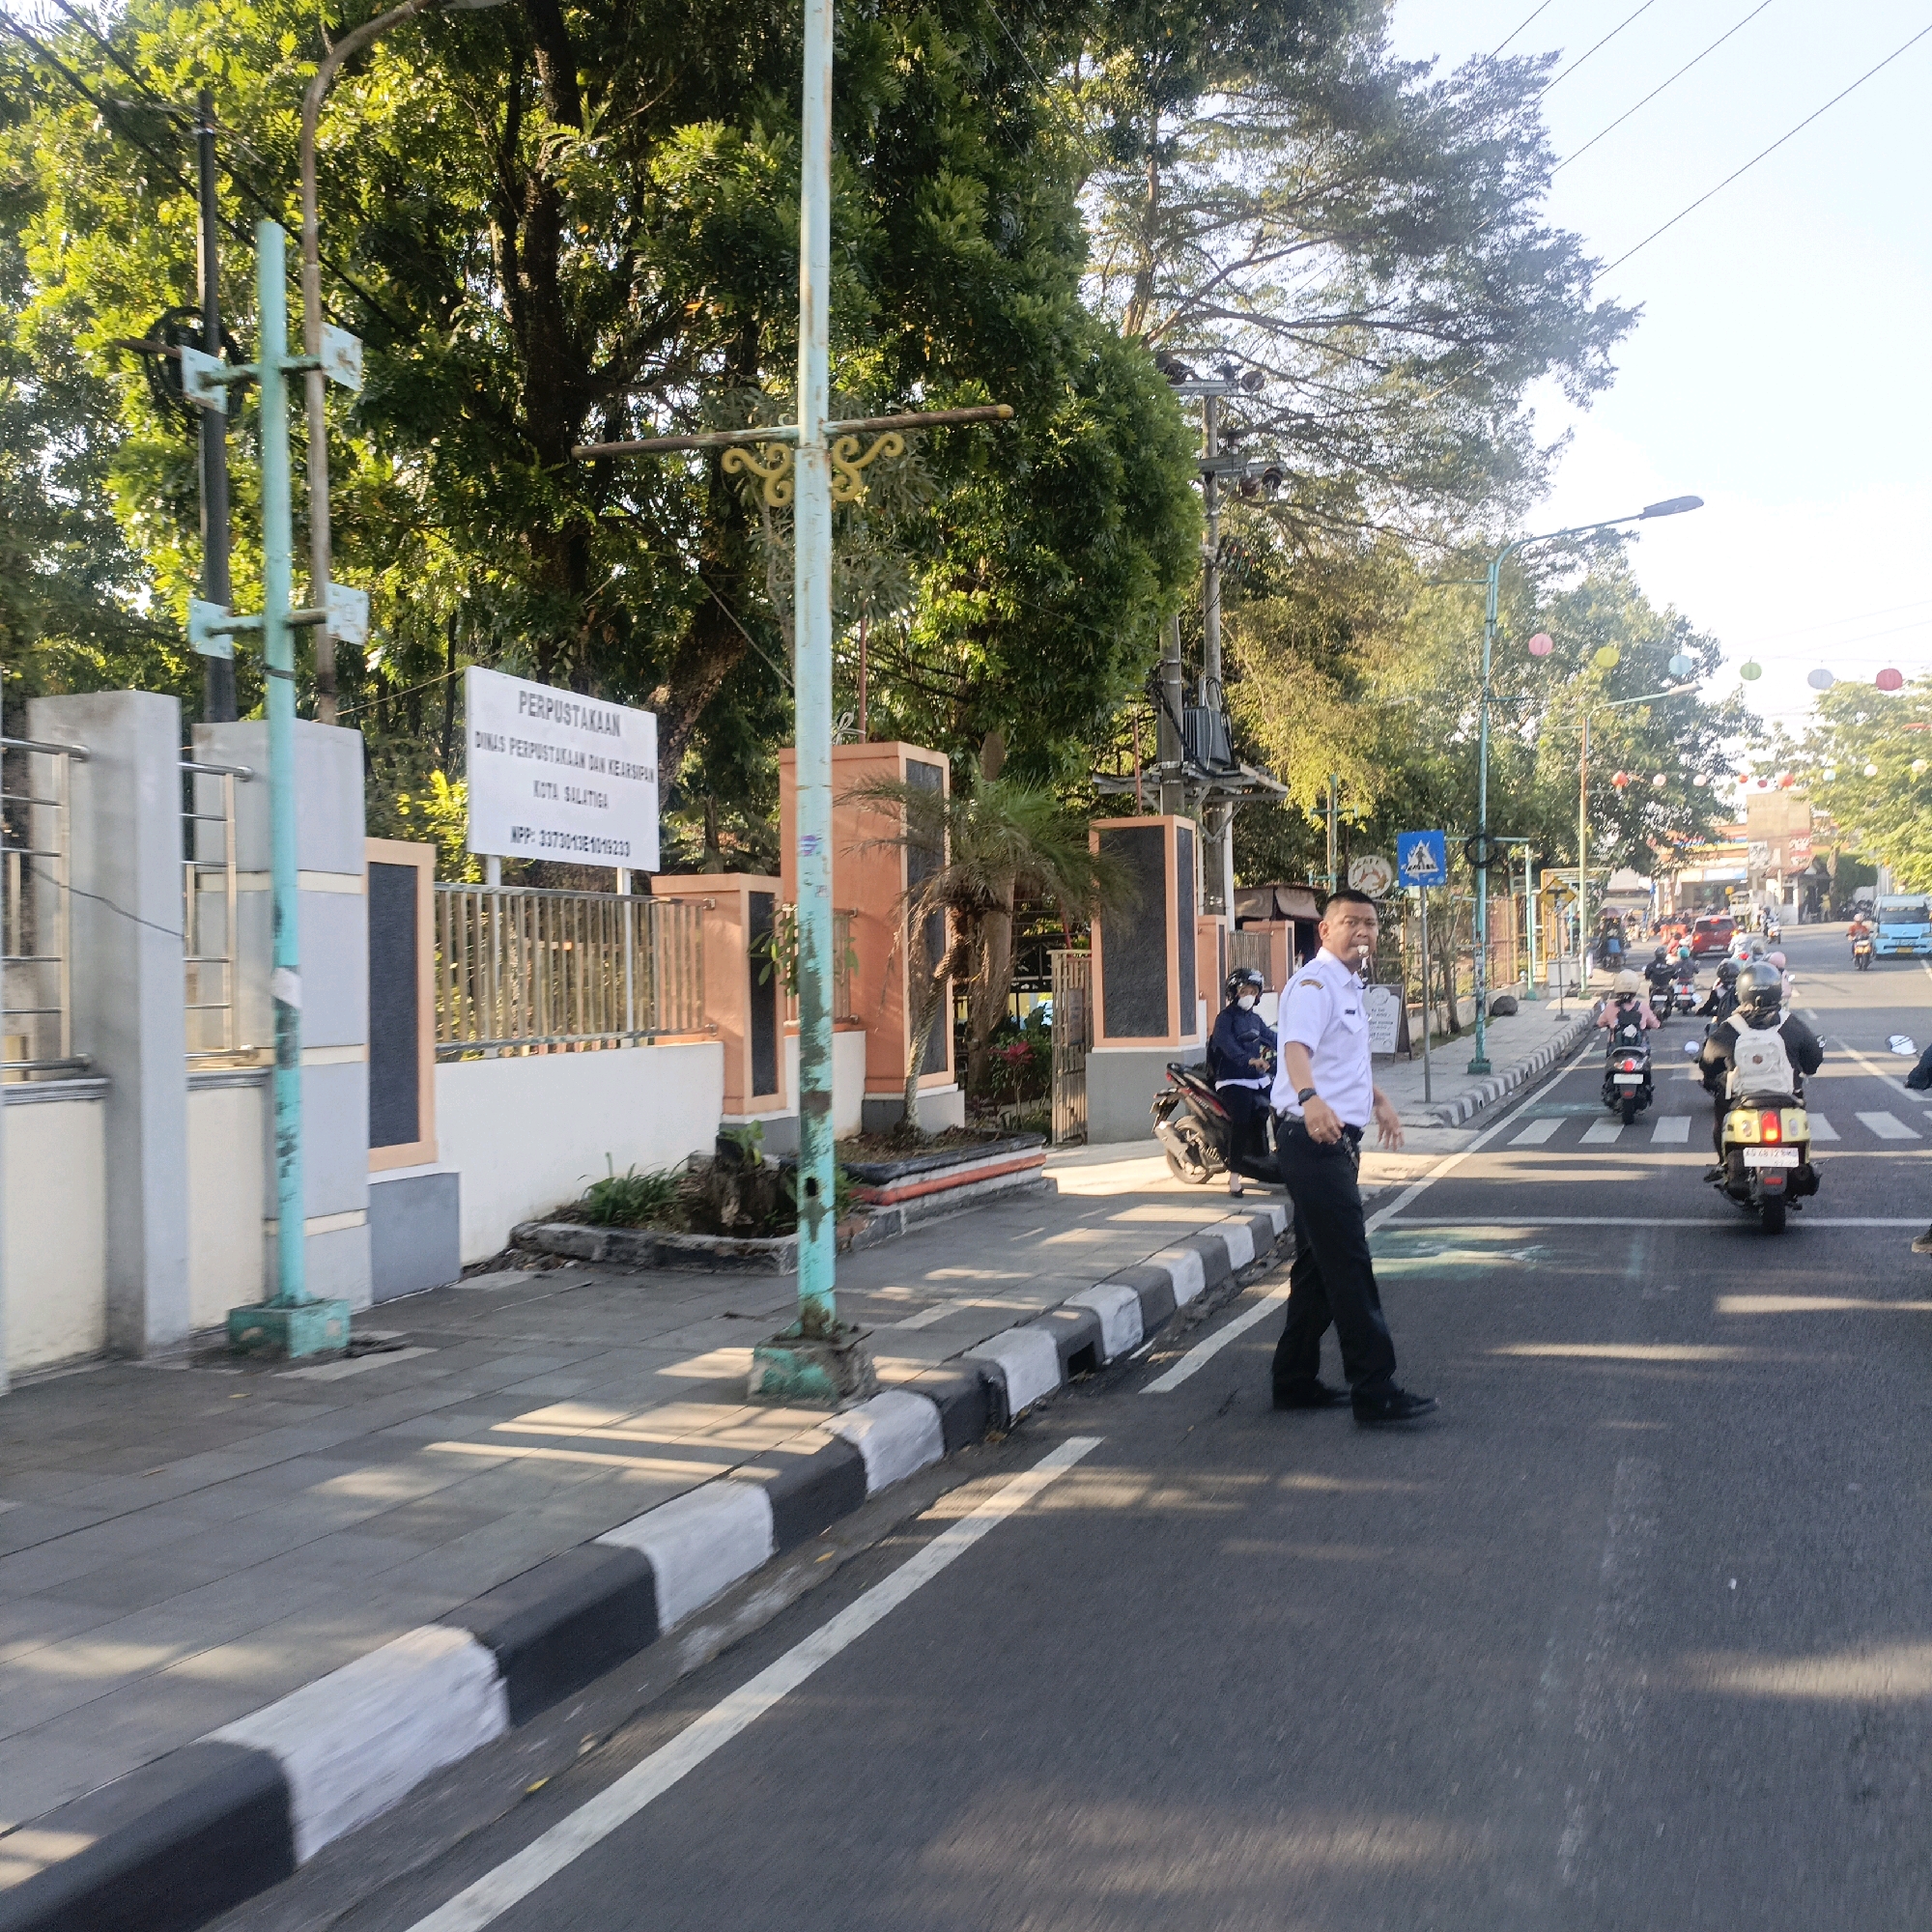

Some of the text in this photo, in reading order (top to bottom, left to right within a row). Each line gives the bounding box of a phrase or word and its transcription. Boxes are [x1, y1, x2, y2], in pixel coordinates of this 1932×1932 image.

[519, 691, 620, 737] PERPUSTAKAAN
[475, 730, 654, 782] DINAS PERPUSTAKAAN DAN KEARSIPAN
[533, 781, 609, 810] KOTA SALATIGA
